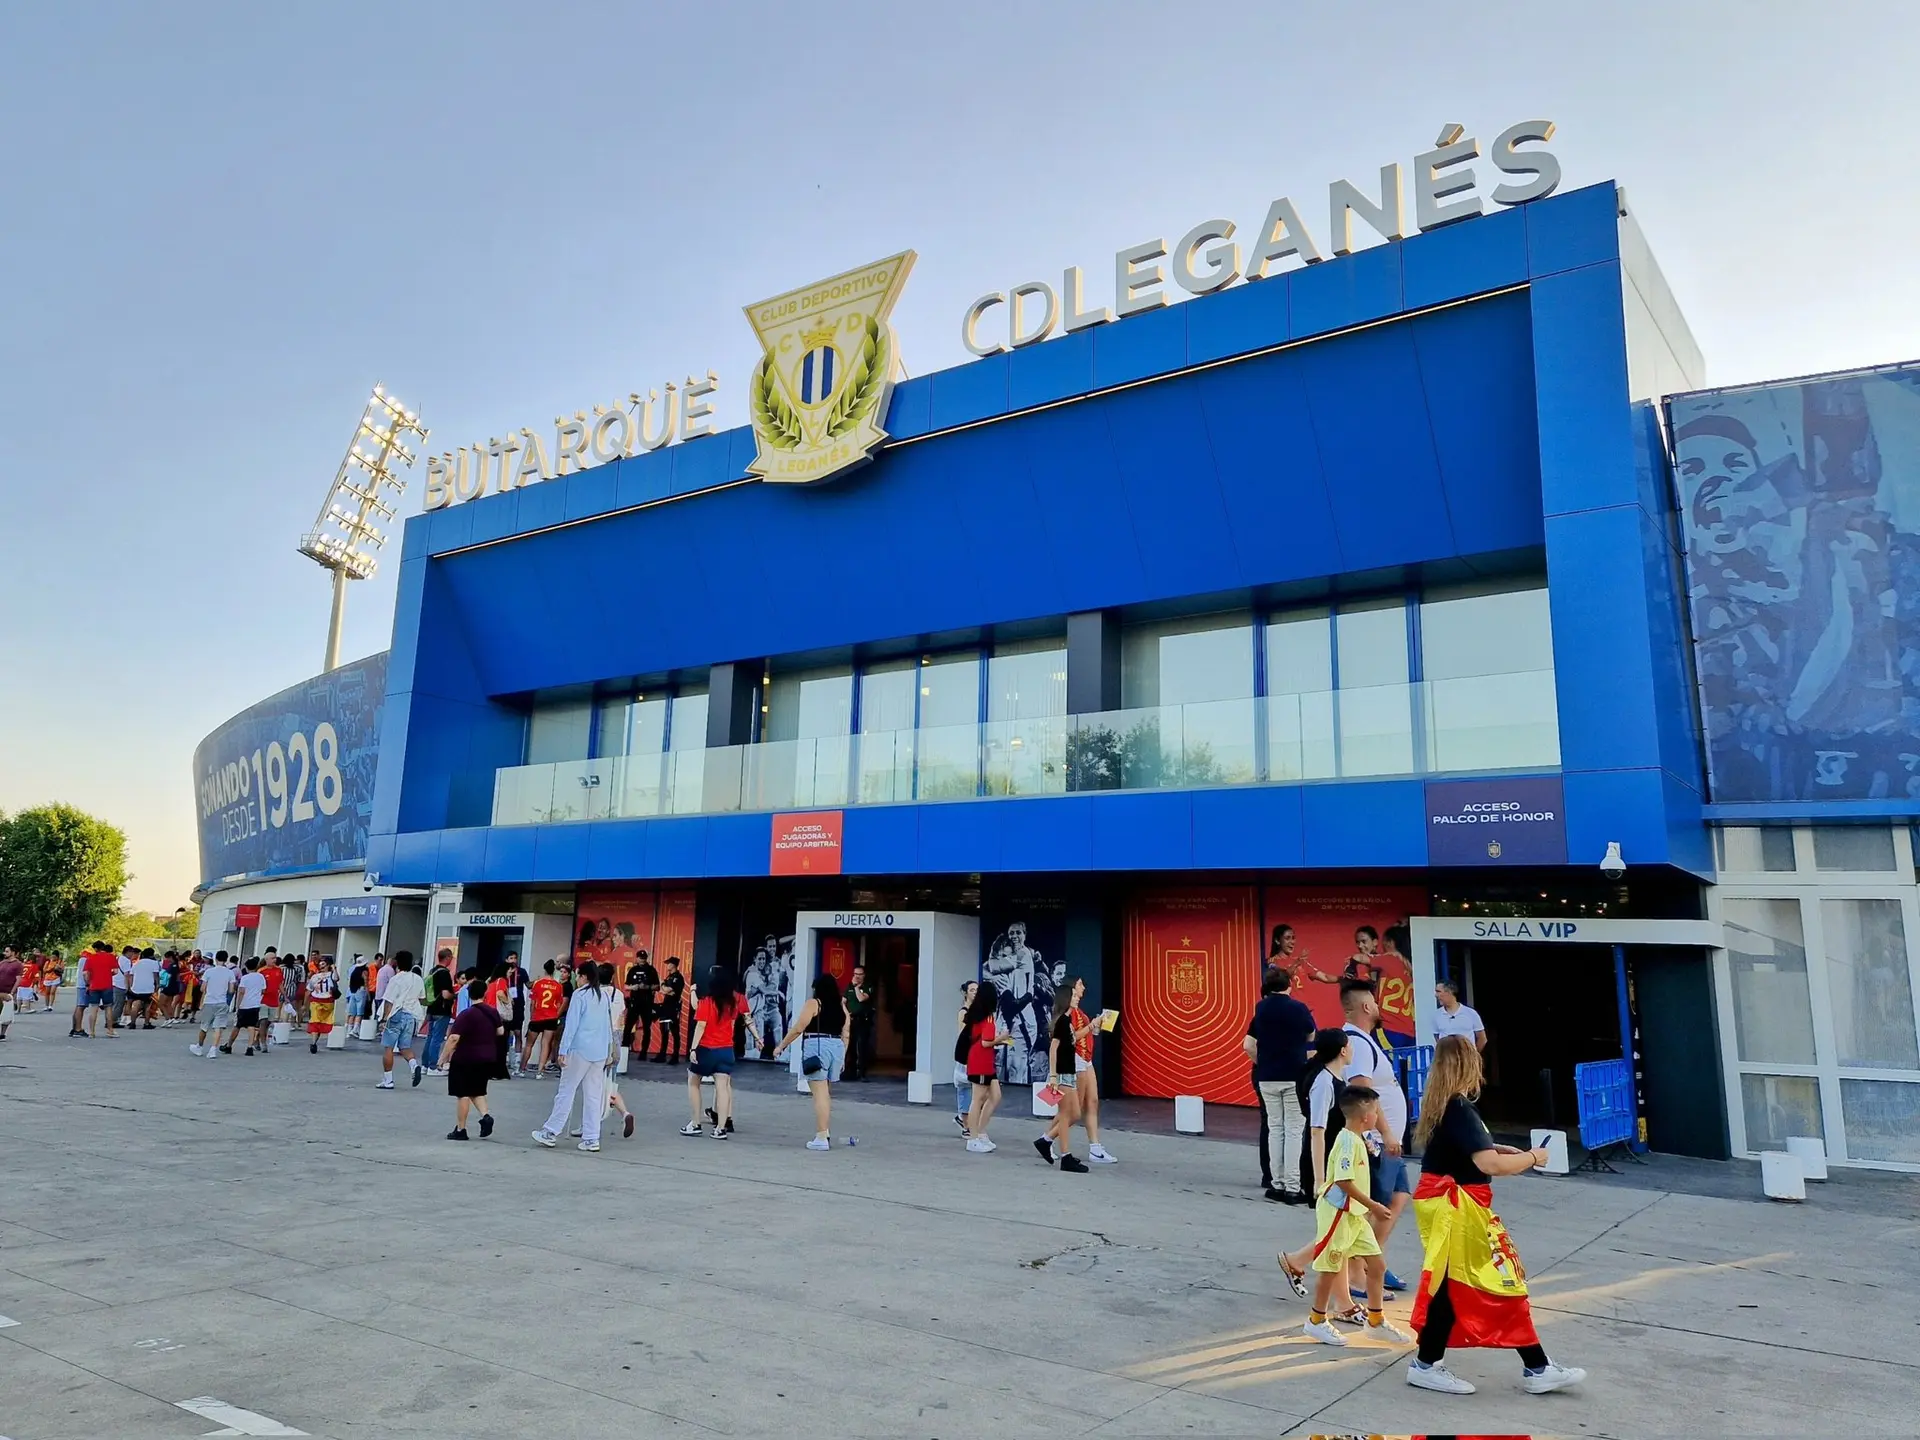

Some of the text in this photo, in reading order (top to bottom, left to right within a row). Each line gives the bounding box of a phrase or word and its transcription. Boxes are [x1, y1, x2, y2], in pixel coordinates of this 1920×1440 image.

[760, 269, 889, 323] CLUB DEPORTIVO
[422, 373, 719, 512] BUTARQUE
[777, 444, 851, 474] LEGANÉS
[252, 721, 343, 832] 1928
[1463, 802, 1521, 812] ACCESO
[222, 801, 257, 846] DESDE
[1432, 812, 1555, 824] PALCO DE HONOR
[781, 833, 827, 841] JUGADORAS
[803, 840, 839, 848] ARBITRAL
[469, 914, 517, 924] LEGASTORE
[834, 913, 894, 926] PUERTA 0
[1474, 921, 1577, 938] SALA VIP
[1294, 975, 1304, 989] 2
[541, 989, 553, 1008] 2
